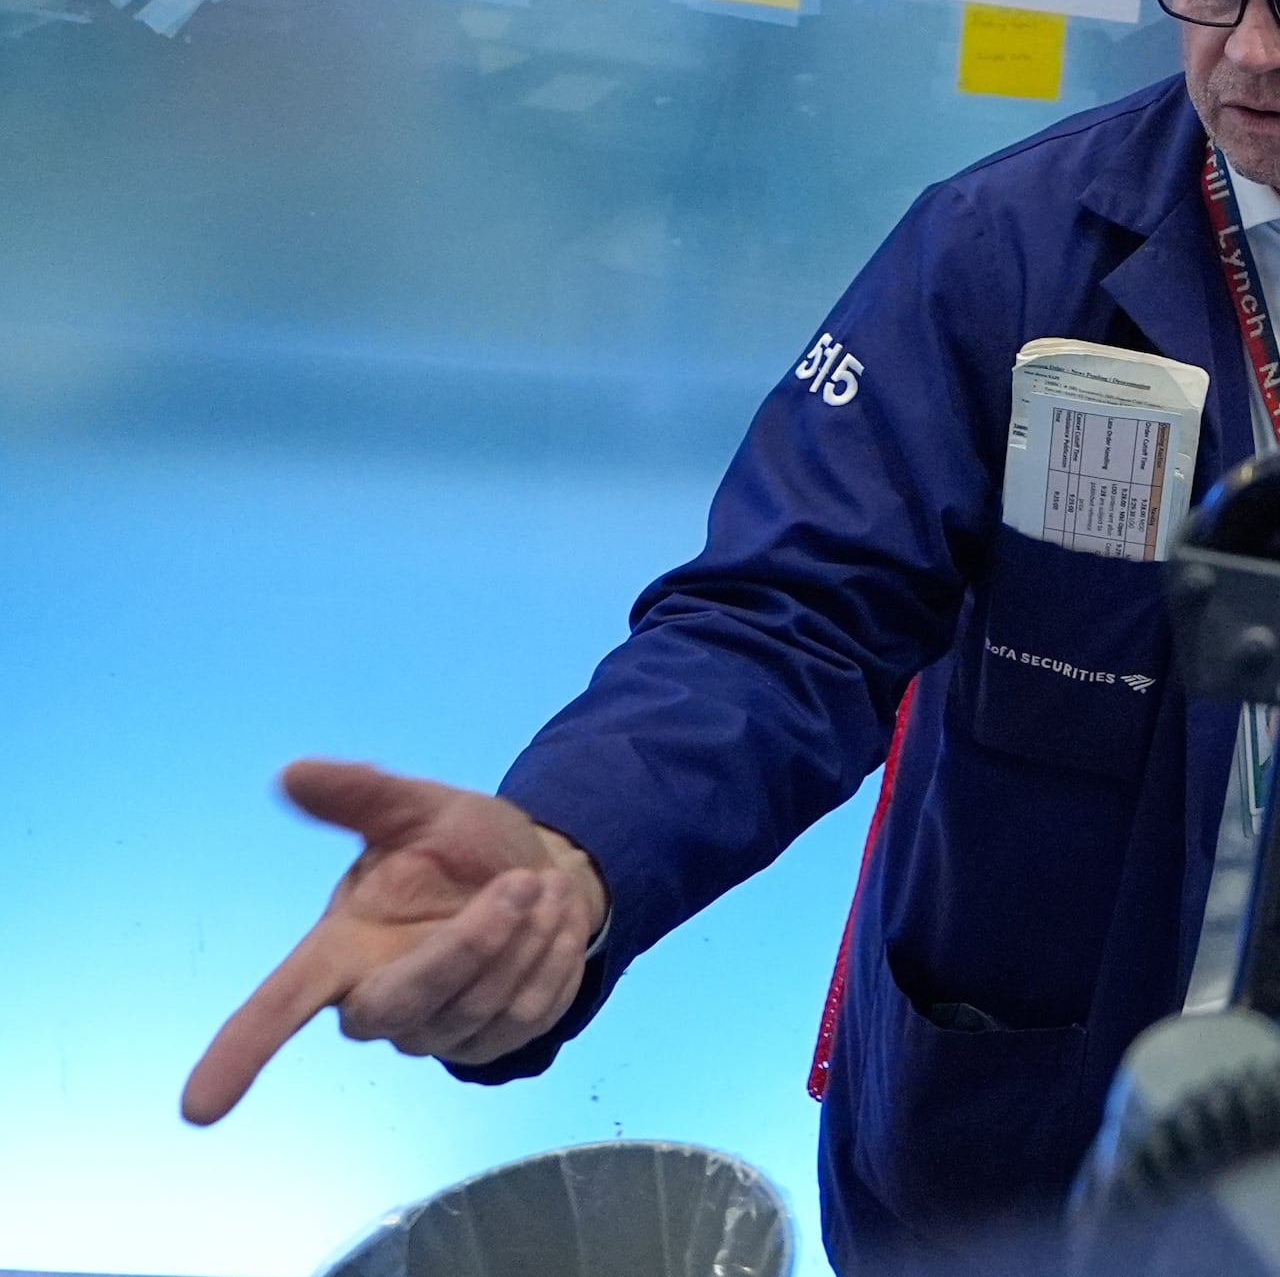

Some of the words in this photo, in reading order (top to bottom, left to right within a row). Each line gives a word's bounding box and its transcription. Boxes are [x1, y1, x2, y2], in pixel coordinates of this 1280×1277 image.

[1218, 225, 1266, 338] Lynch
[795, 333, 865, 406] 515
[1062, 439, 1070, 468] Publication
[1074, 431, 1082, 448] Cutoff
[1142, 439, 1150, 456] Cutoff
[1102, 447, 1110, 470] Handling
[1020, 652, 1116, 684] SECURITIES
